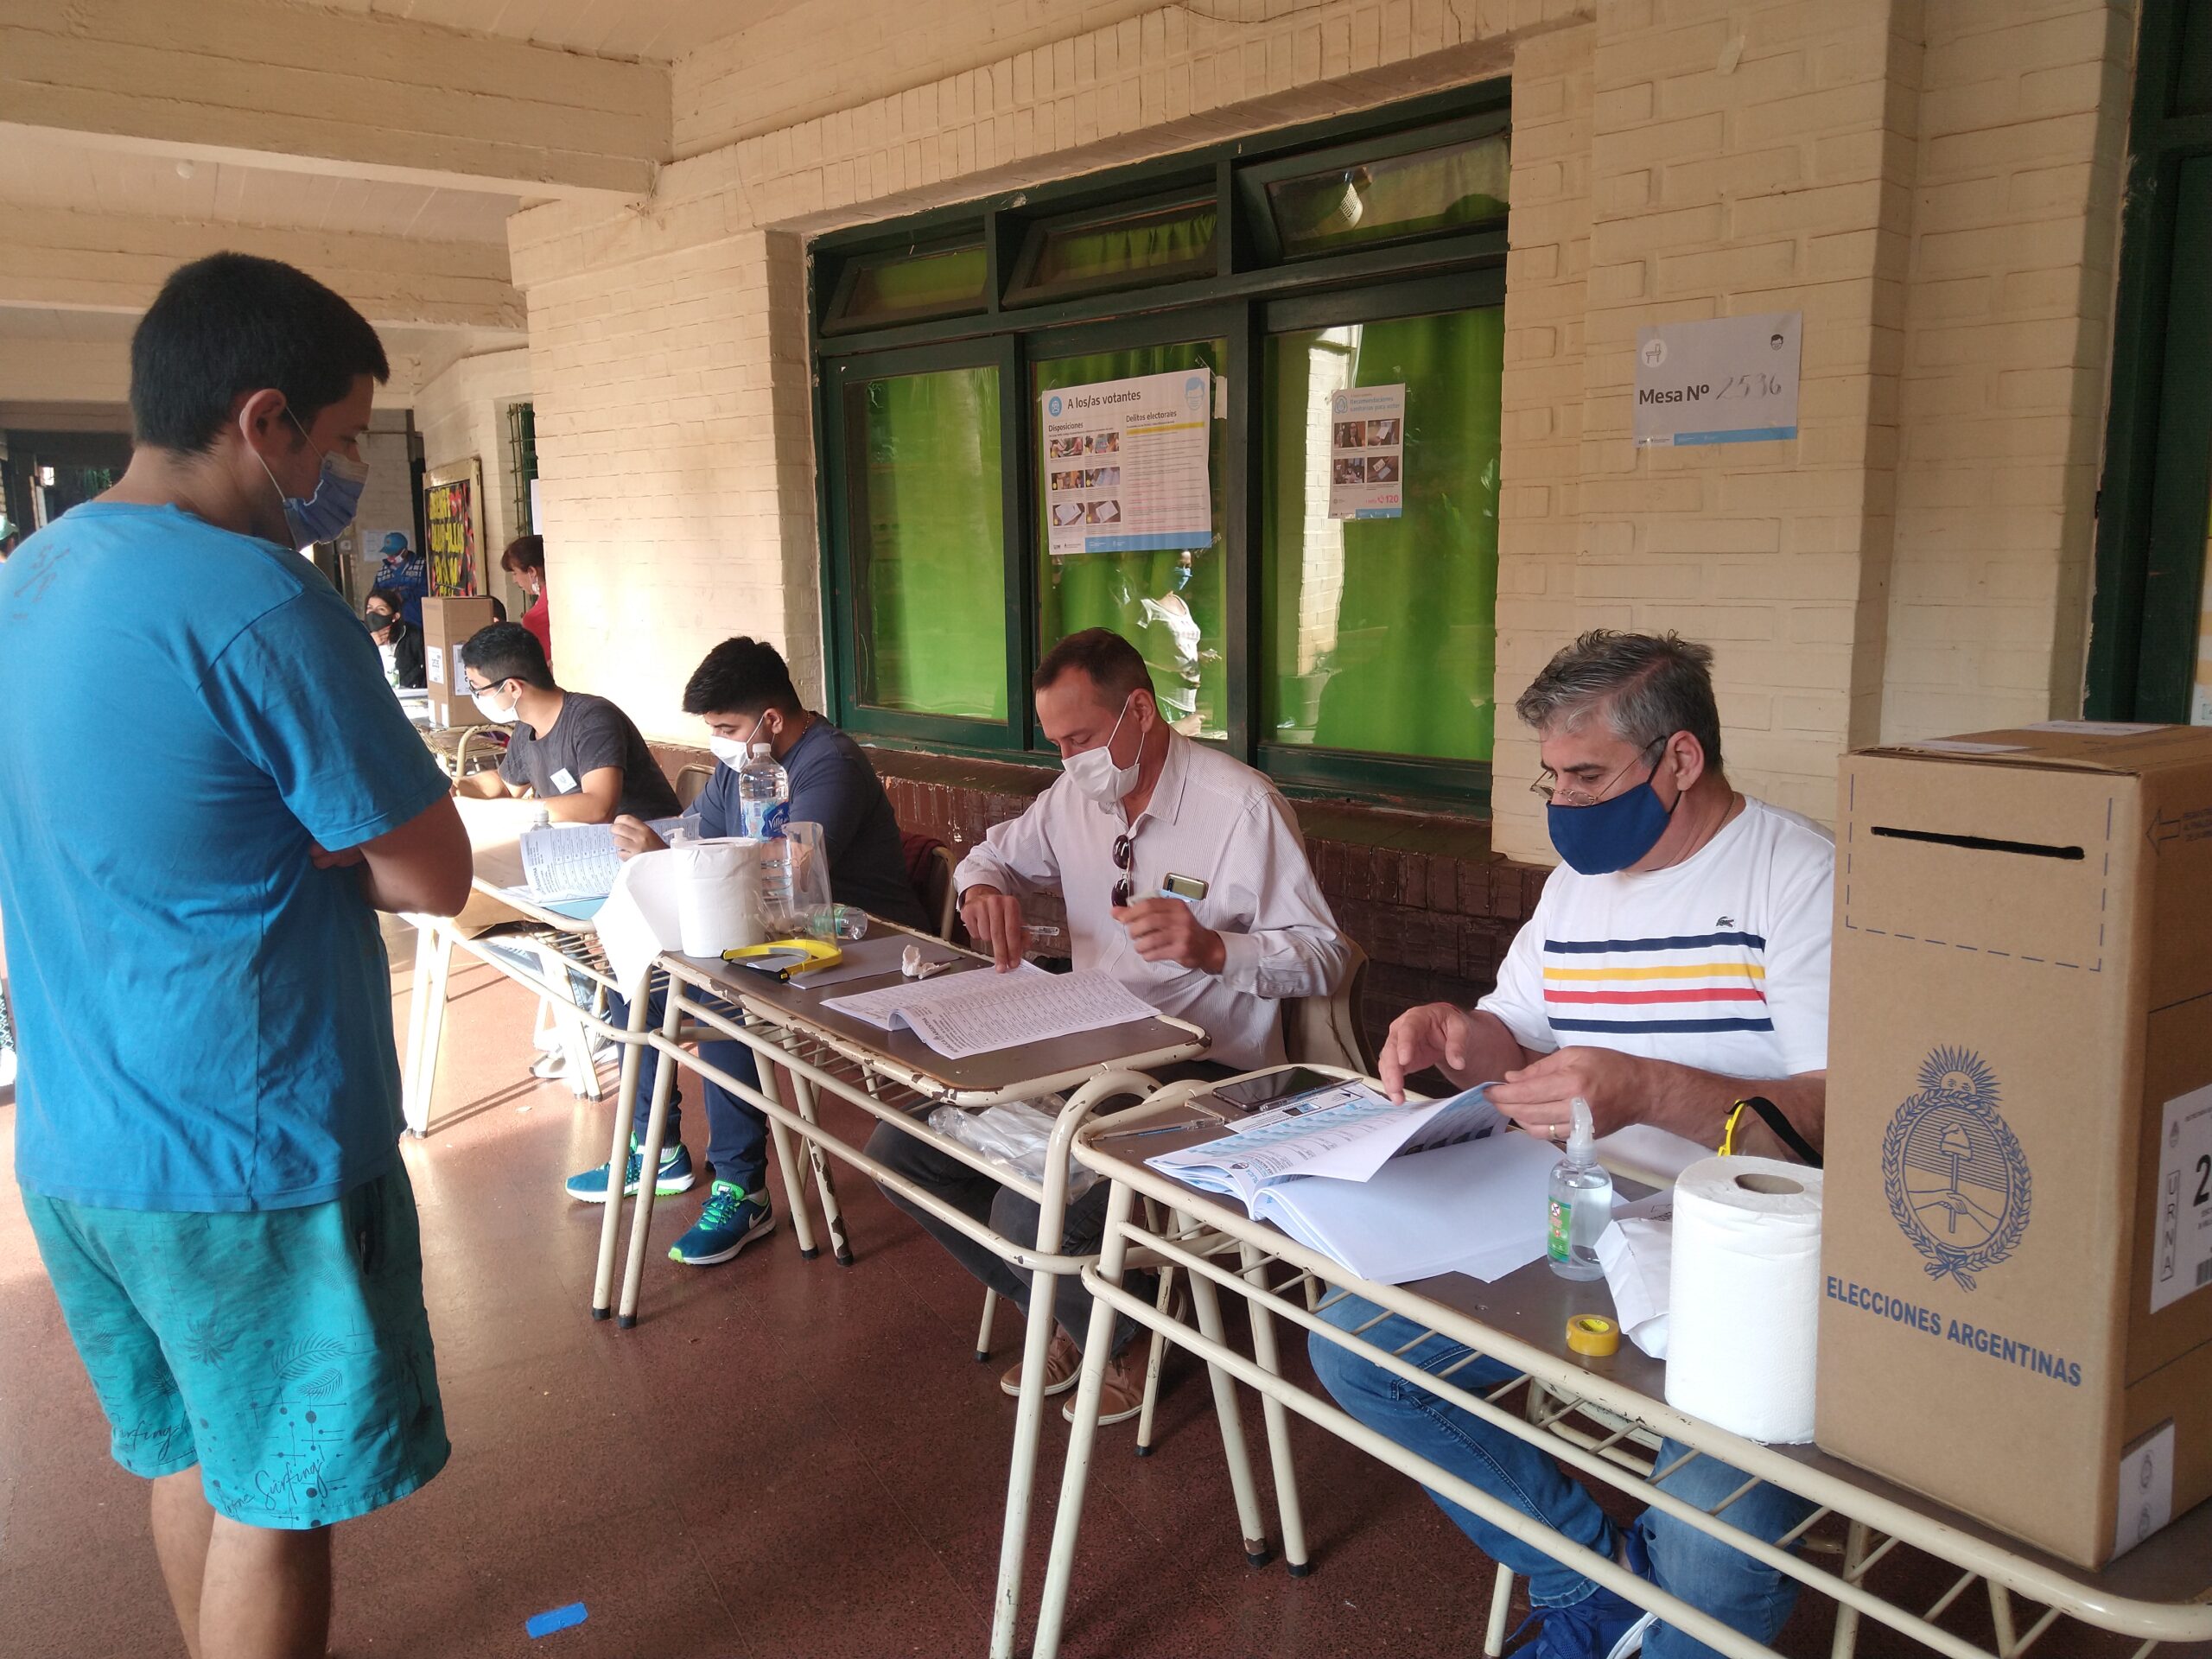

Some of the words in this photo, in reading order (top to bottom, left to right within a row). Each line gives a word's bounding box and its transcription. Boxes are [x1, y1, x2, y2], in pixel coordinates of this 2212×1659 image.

[1067, 398, 1074, 410] A
[1075, 394, 1101, 409] los/as
[1102, 390, 1141, 405] votantes
[1638, 390, 1683, 405] Mesa
[1126, 414, 1146, 423] Delitos
[1147, 410, 1177, 422] electorales
[1048, 422, 1084, 435] Disposiciones
[2163, 1177, 2178, 1274] URNA
[1826, 1275, 1942, 1336] ELECCIONES
[1946, 1319, 2082, 1387] ARGENTINAS
